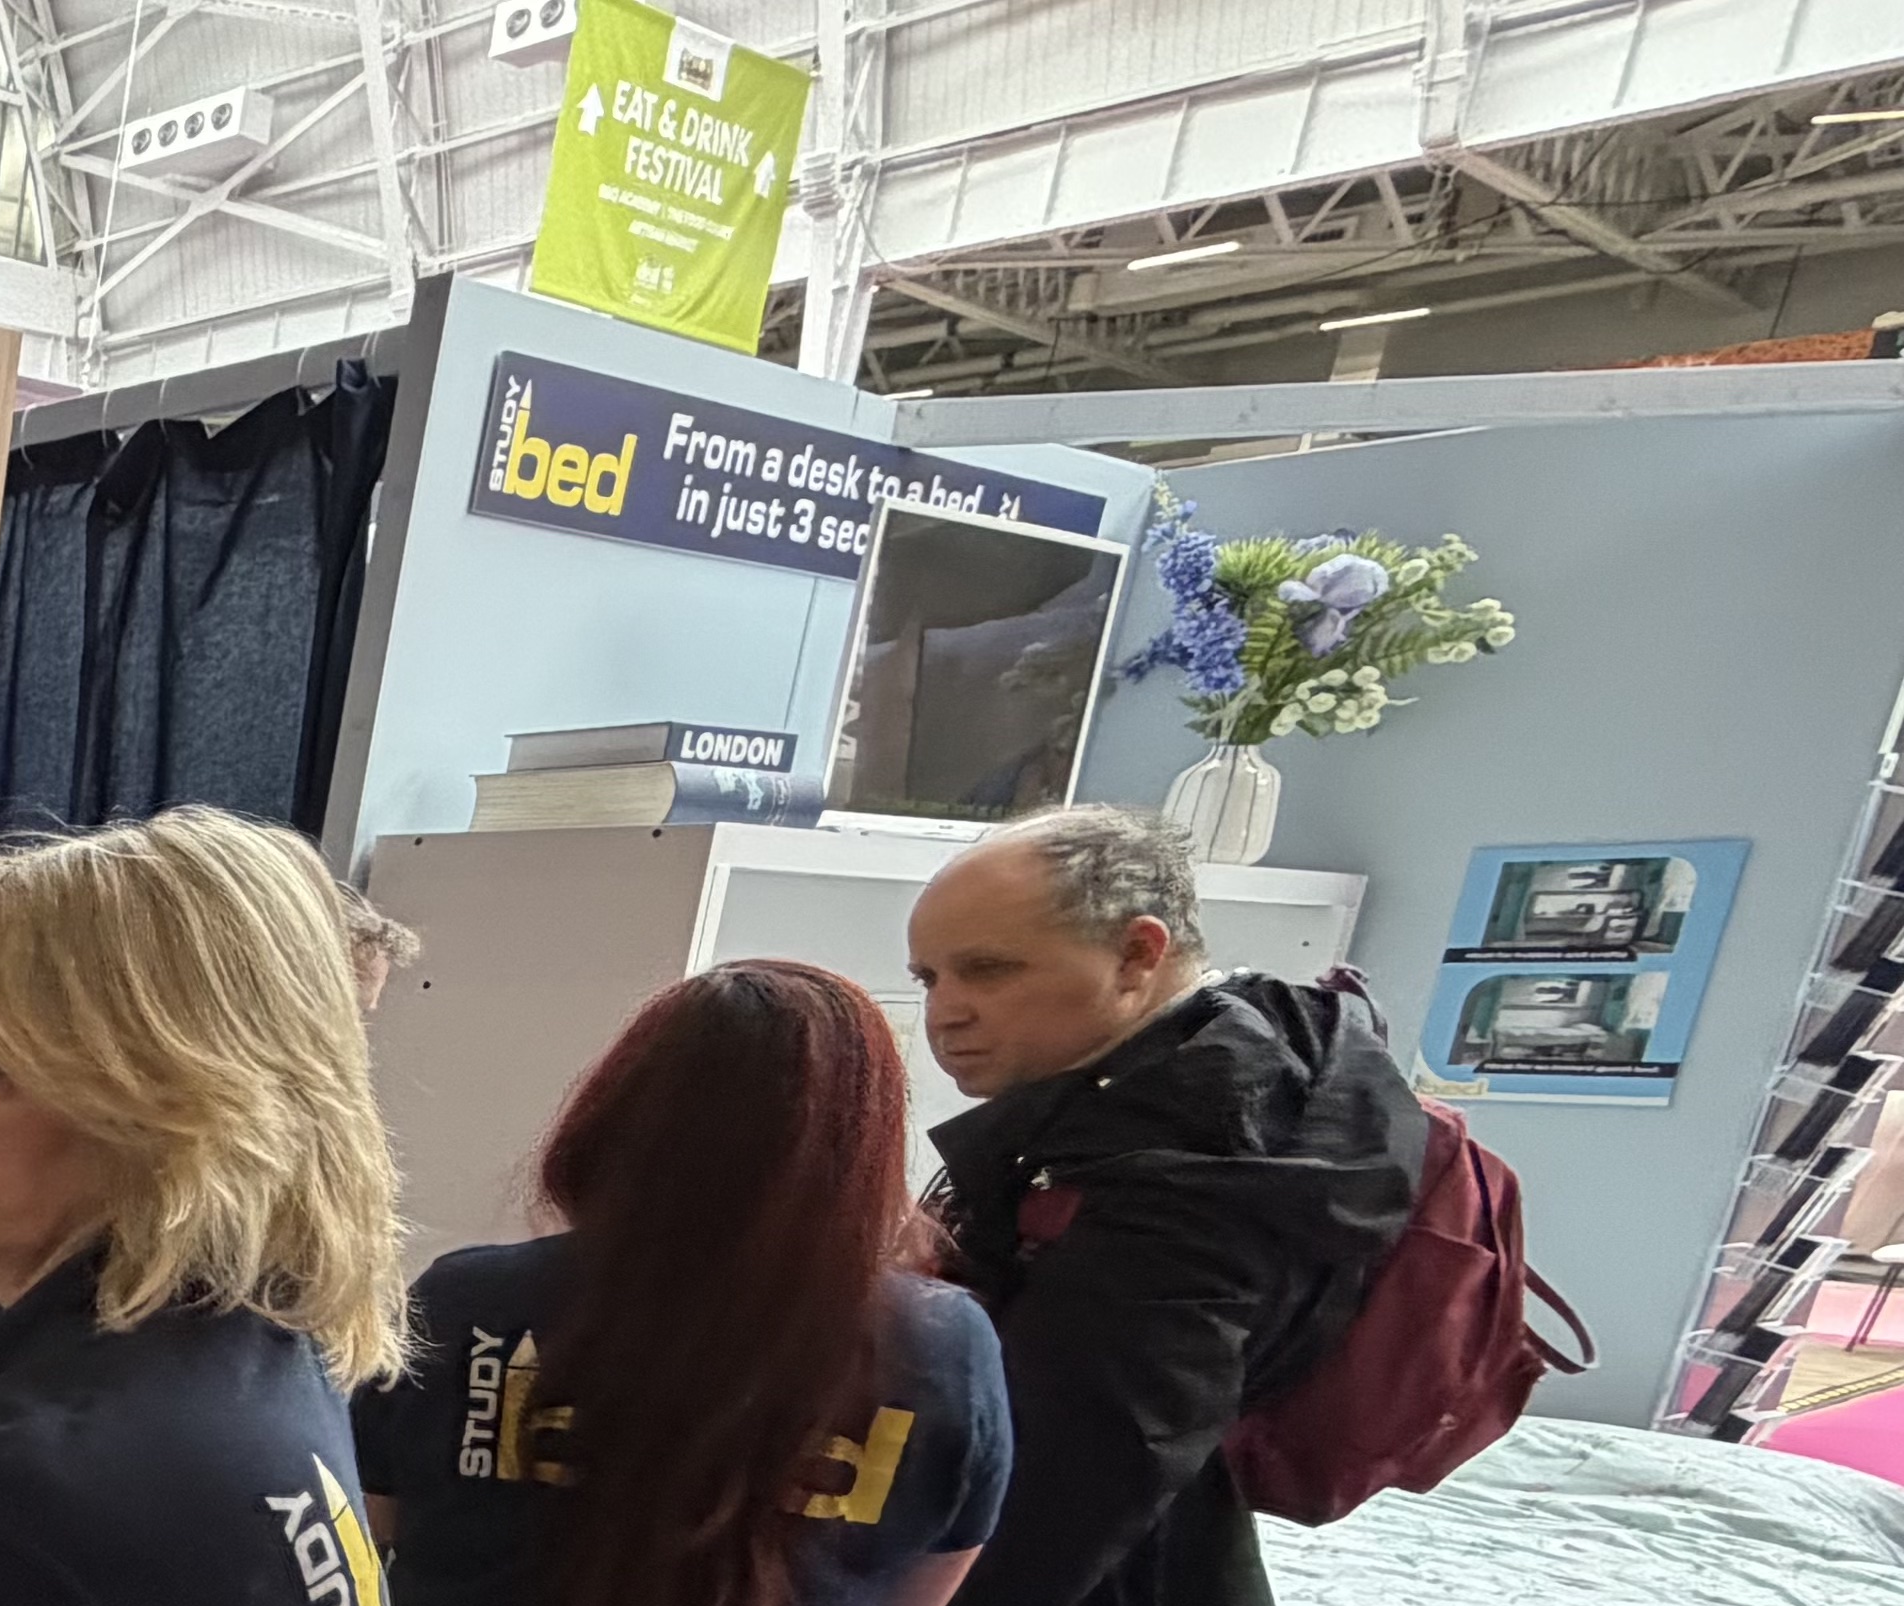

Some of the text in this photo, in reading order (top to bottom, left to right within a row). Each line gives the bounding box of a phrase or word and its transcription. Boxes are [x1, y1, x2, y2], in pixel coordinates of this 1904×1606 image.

[612, 80, 753, 167] EAT & DRINK
[624, 135, 723, 206] FESTIVAL
[489, 375, 521, 491] STUDY
[502, 379, 638, 516] bed
[663, 412, 755, 477] From
[760, 448, 783, 483] a
[787, 444, 865, 500] desk
[867, 465, 900, 501] to
[906, 481, 924, 505] a
[675, 474, 711, 524] in
[710, 483, 786, 538] just
[788, 499, 816, 544] 3
[680, 730, 784, 767] LONDON
[459, 1326, 507, 1479] STUDY
